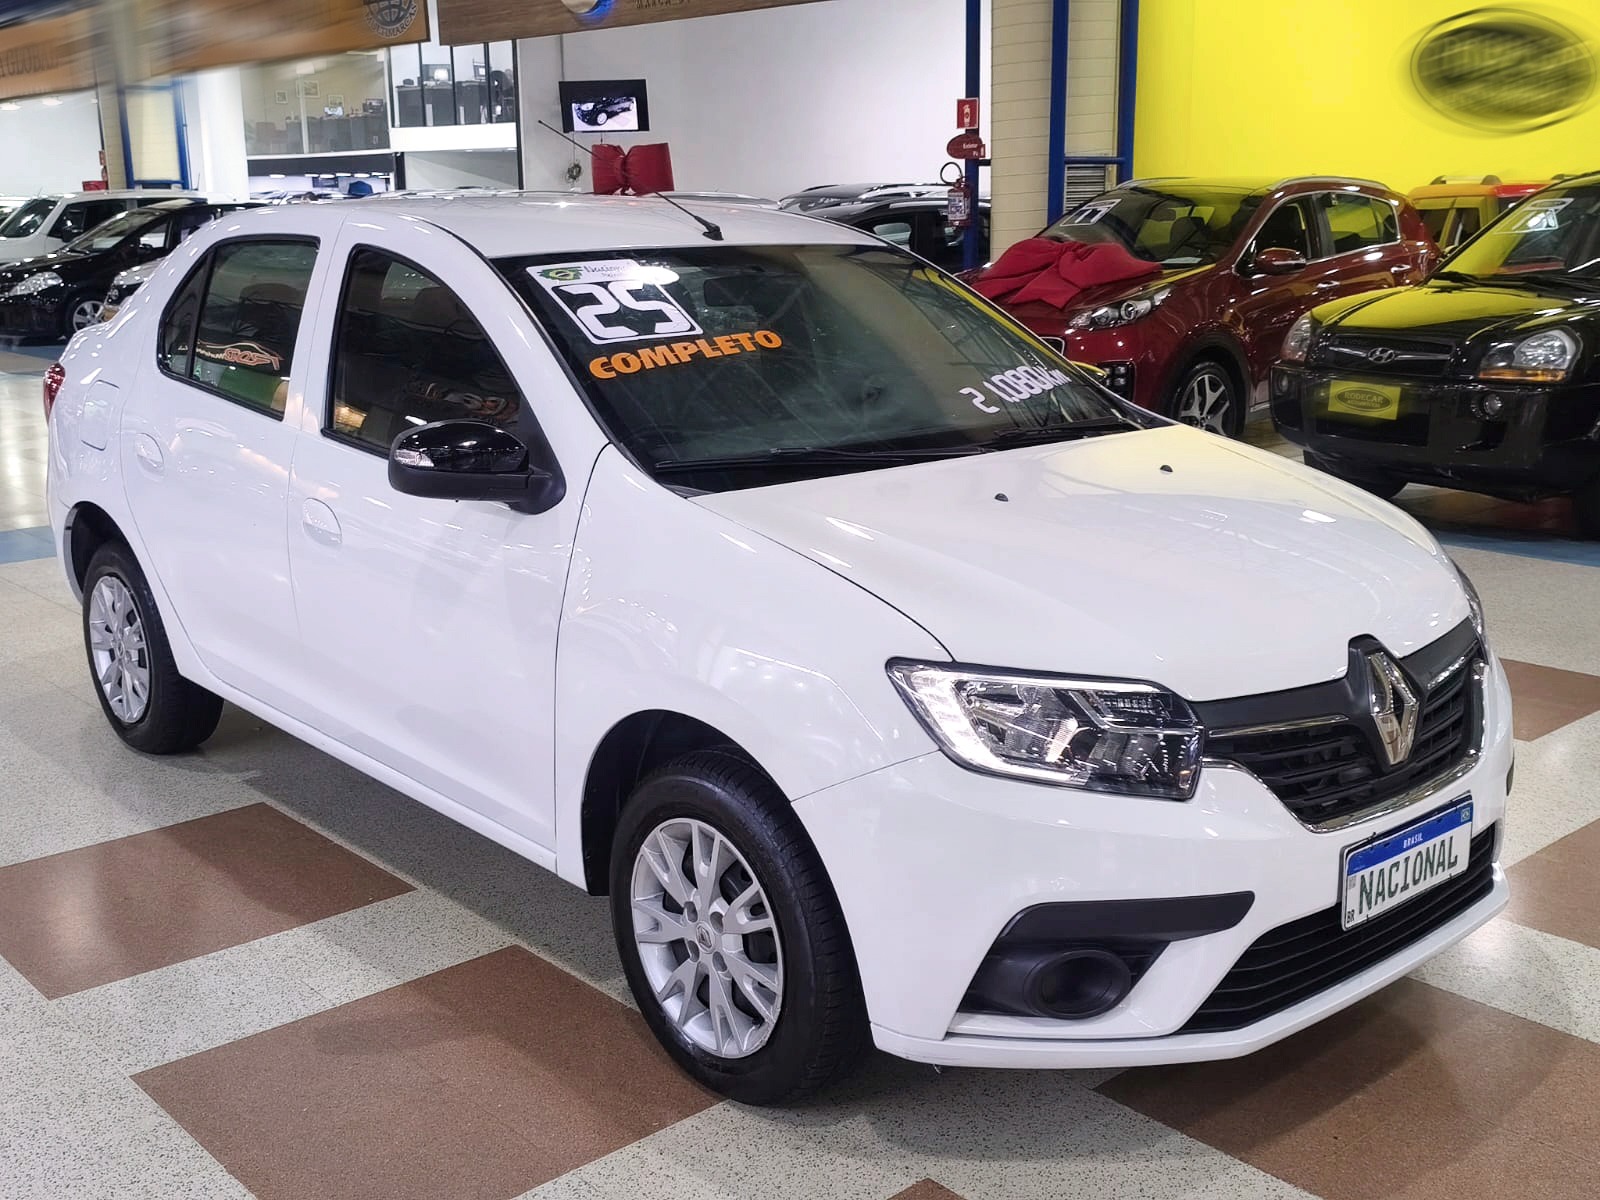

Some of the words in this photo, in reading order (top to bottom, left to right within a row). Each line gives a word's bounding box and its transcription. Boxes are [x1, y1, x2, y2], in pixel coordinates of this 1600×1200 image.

[558, 280, 691, 338] 25
[589, 330, 783, 379] COMPLETO
[1403, 833, 1423, 848] BRASIL
[1359, 836, 1458, 914] NACIONAL
[1346, 909, 1355, 923] BR
